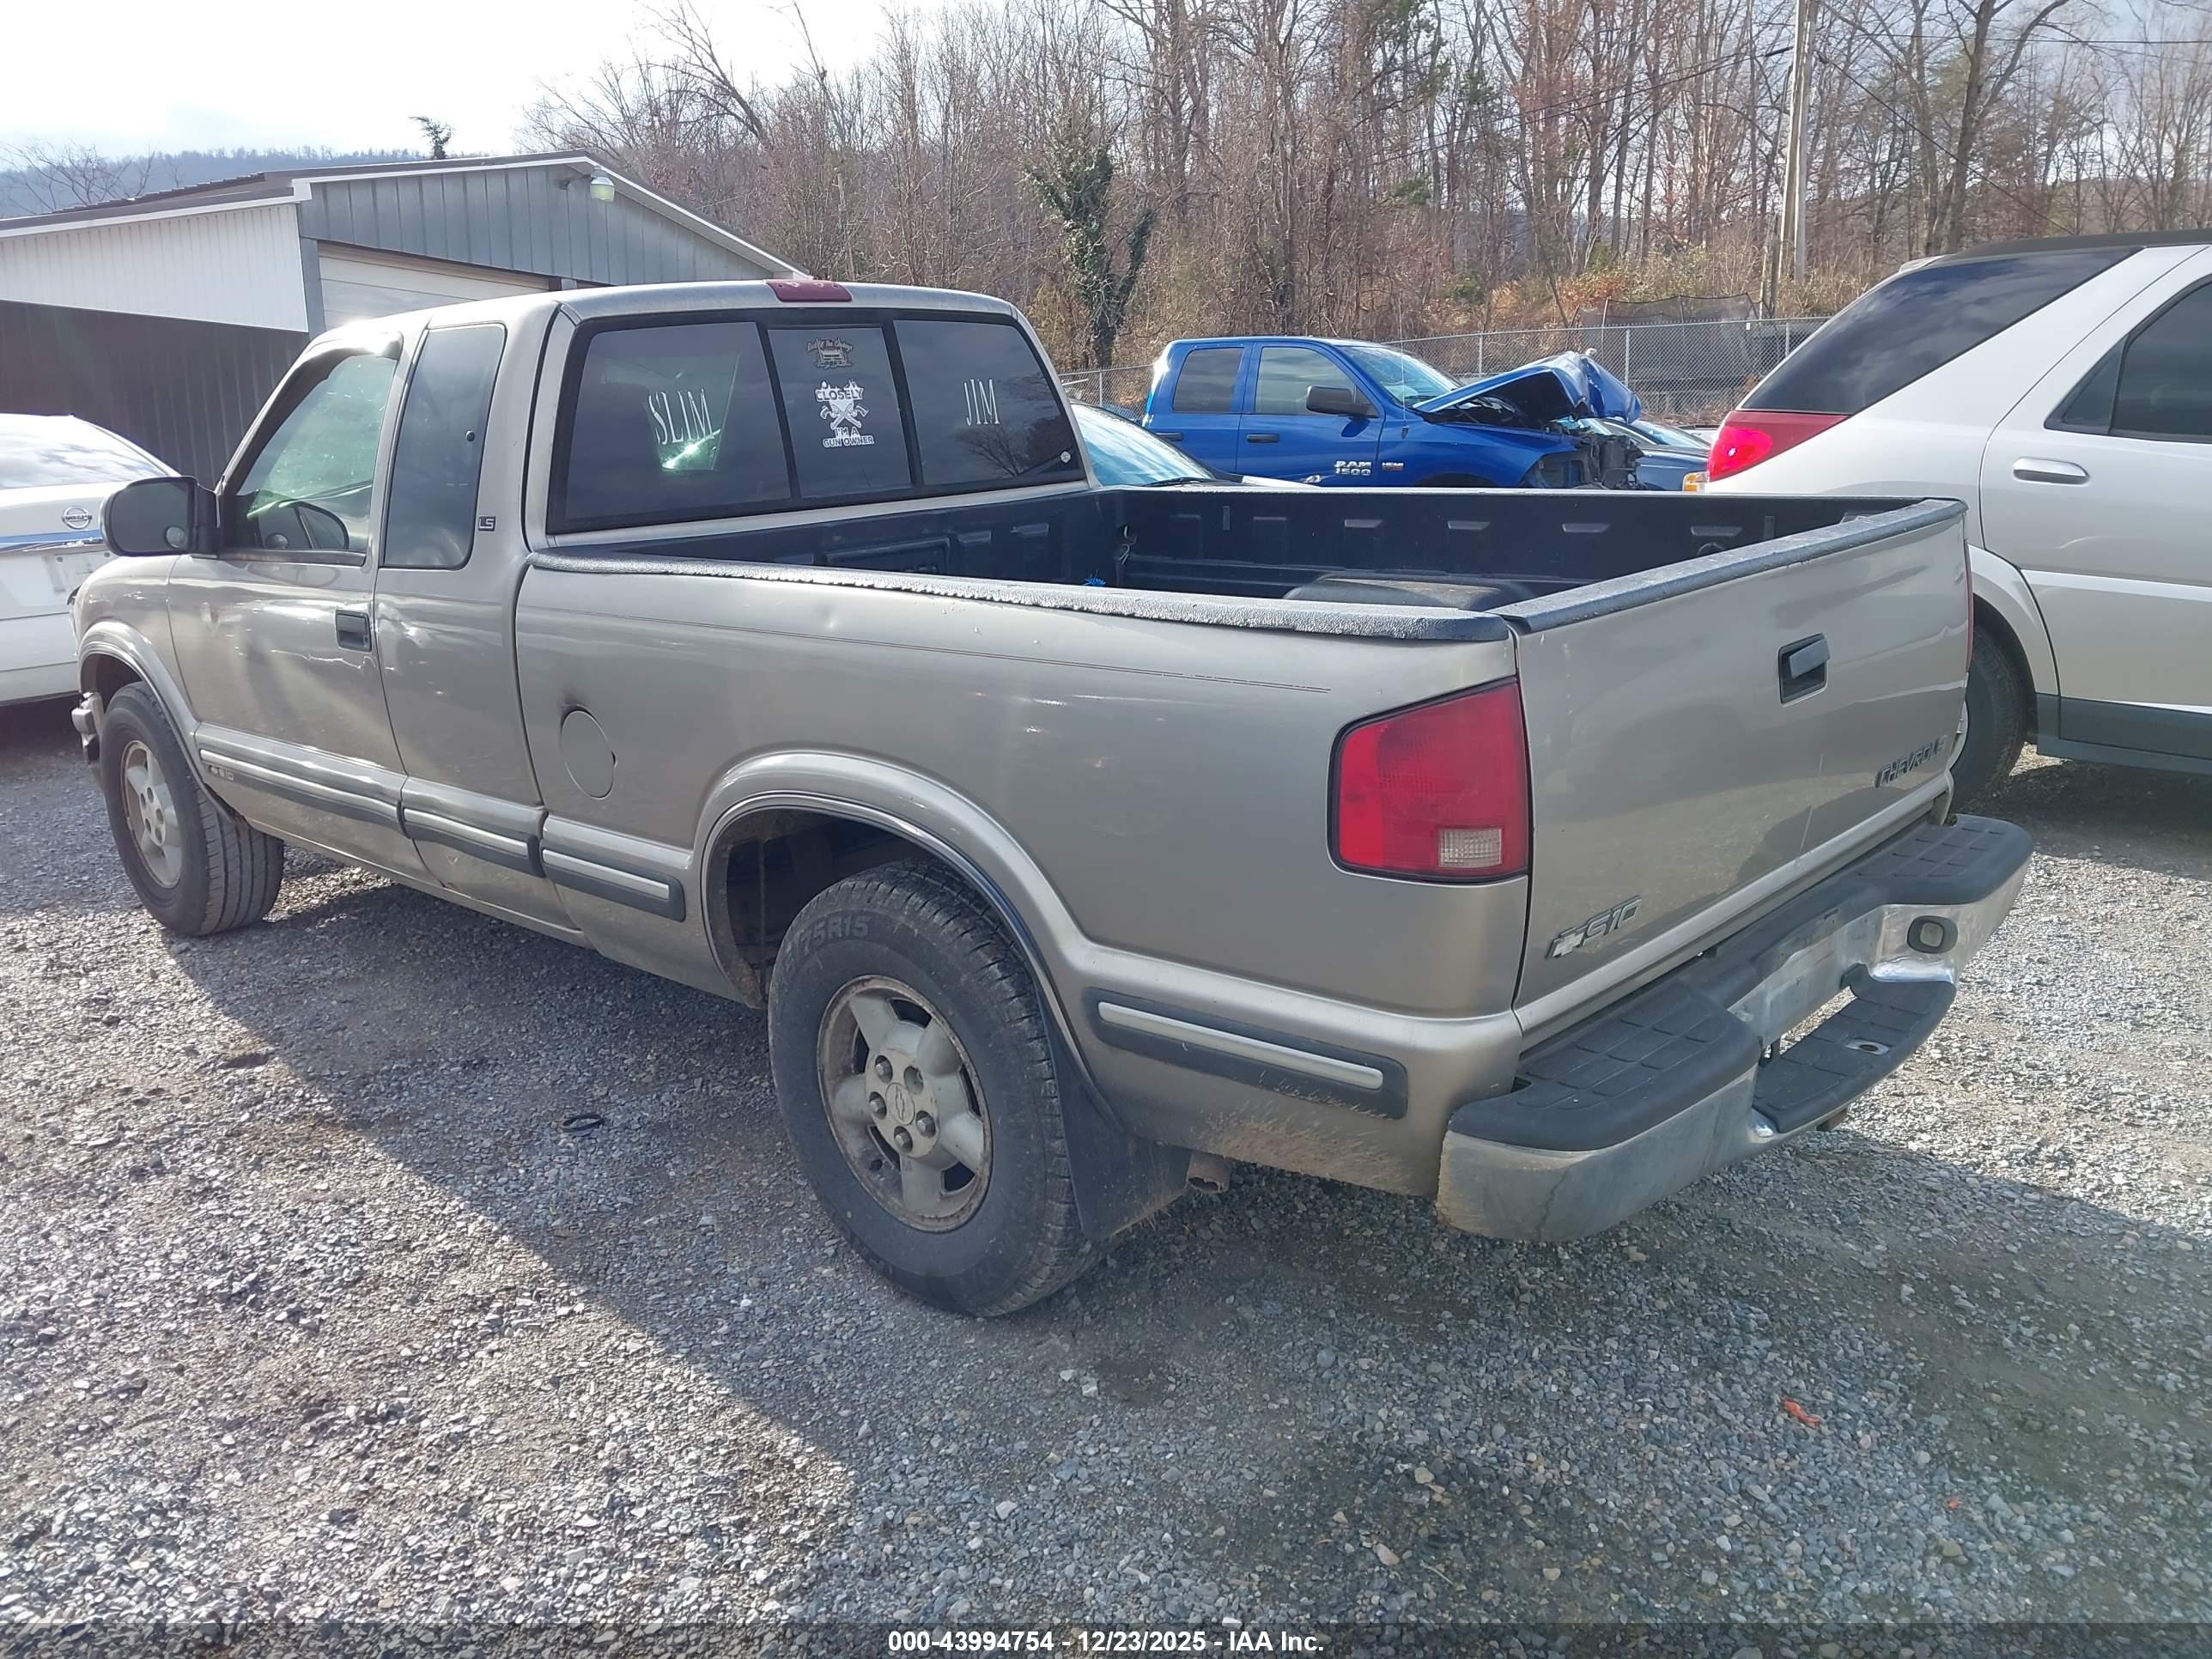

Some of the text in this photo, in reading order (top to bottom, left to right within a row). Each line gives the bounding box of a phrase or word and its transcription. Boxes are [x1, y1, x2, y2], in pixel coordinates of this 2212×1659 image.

[816, 389, 864, 401] CLOSELY
[648, 378, 1000, 445] SLIM JIM
[851, 427, 860, 436] A
[823, 434, 875, 447] GUN OWNER
[478, 517, 495, 530] LS
